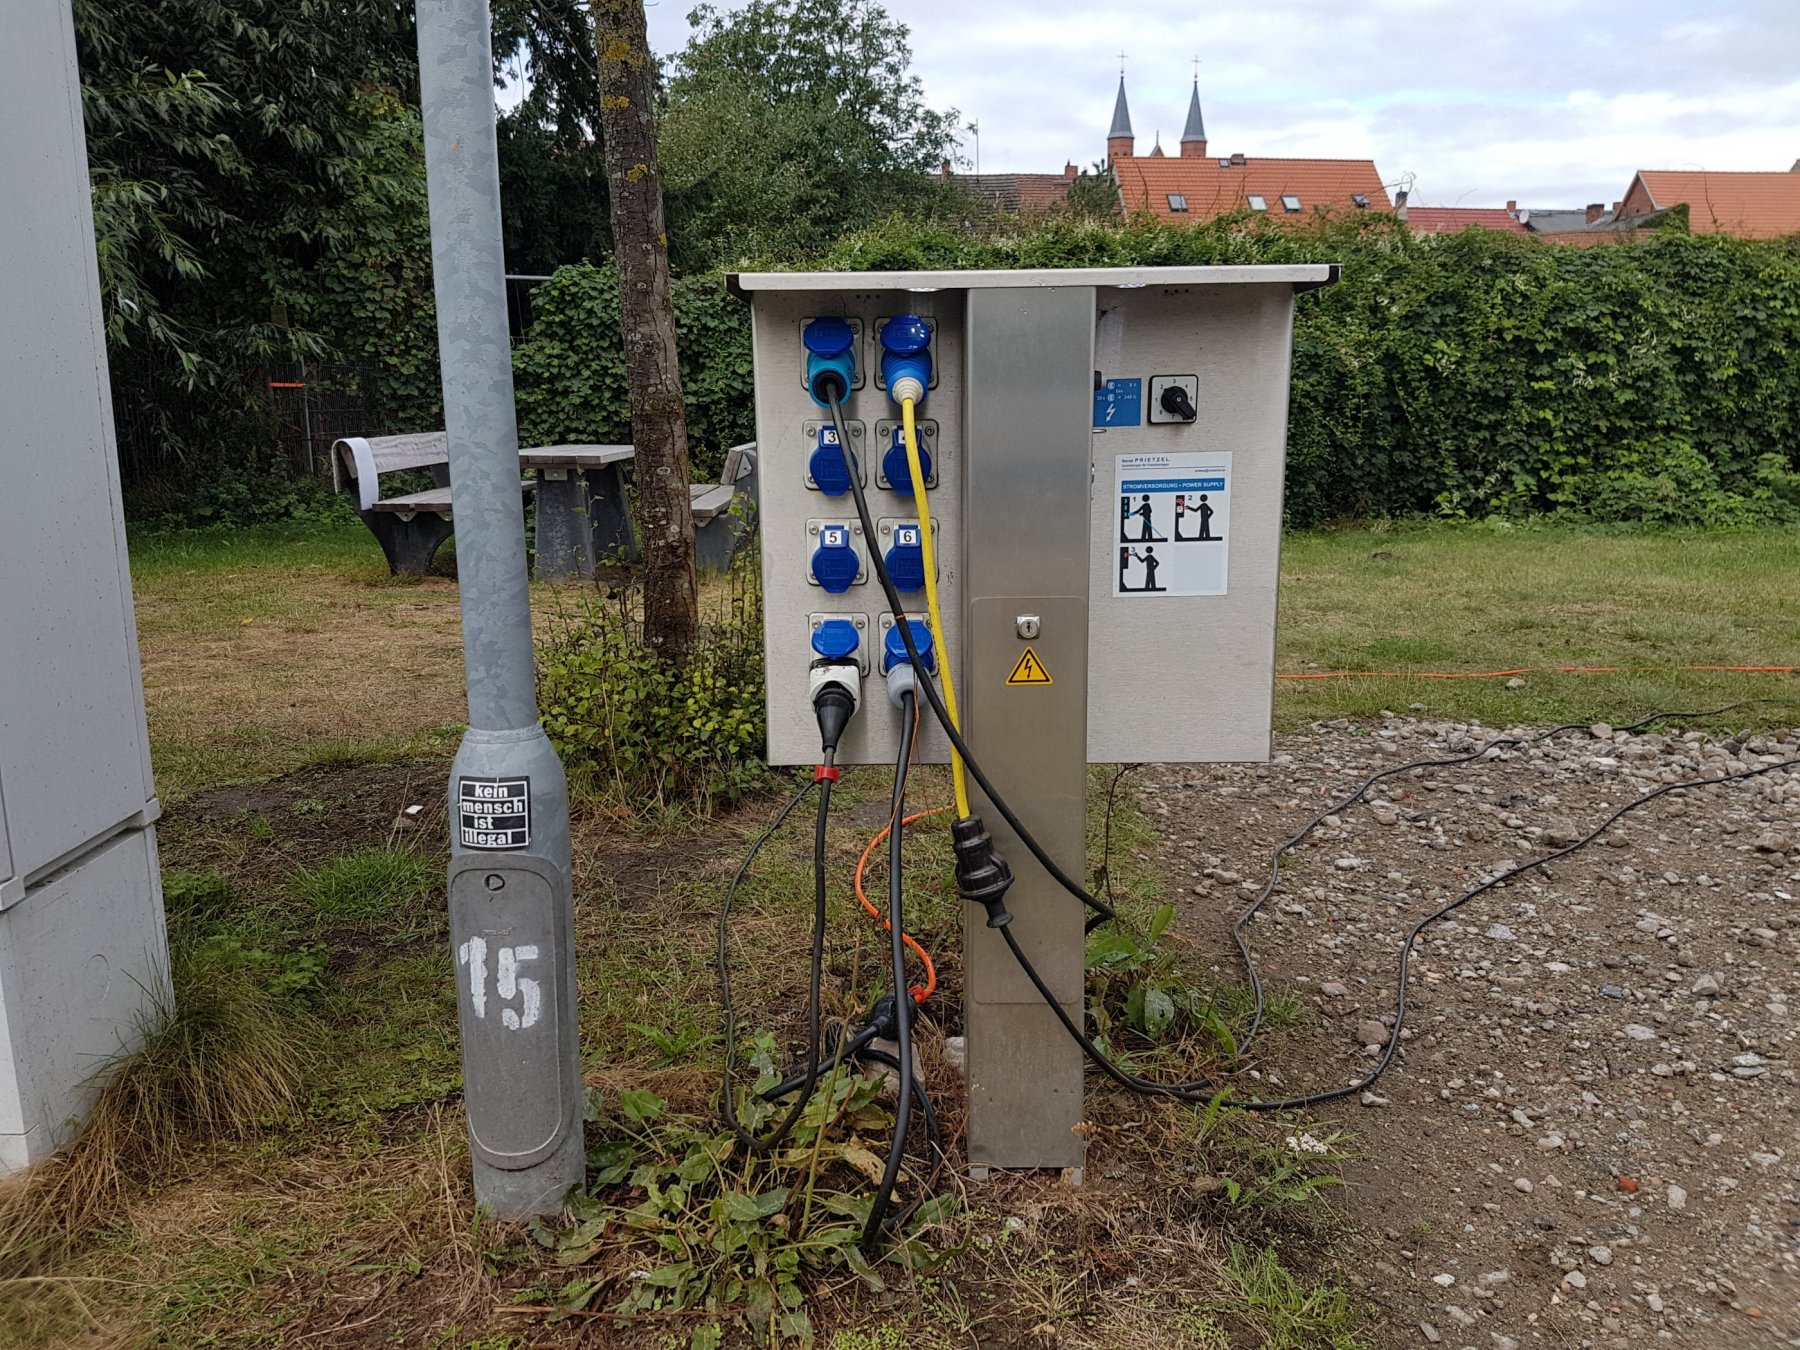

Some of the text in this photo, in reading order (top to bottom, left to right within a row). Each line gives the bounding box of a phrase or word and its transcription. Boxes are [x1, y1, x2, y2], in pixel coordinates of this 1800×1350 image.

[828, 431, 837, 444] 3
[829, 531, 838, 544] 5
[903, 530, 912, 543] 6
[474, 783, 508, 798] kein
[462, 799, 523, 814] mensch
[473, 815, 494, 829] ist
[463, 830, 512, 846] illegal
[459, 936, 541, 1031] 15
